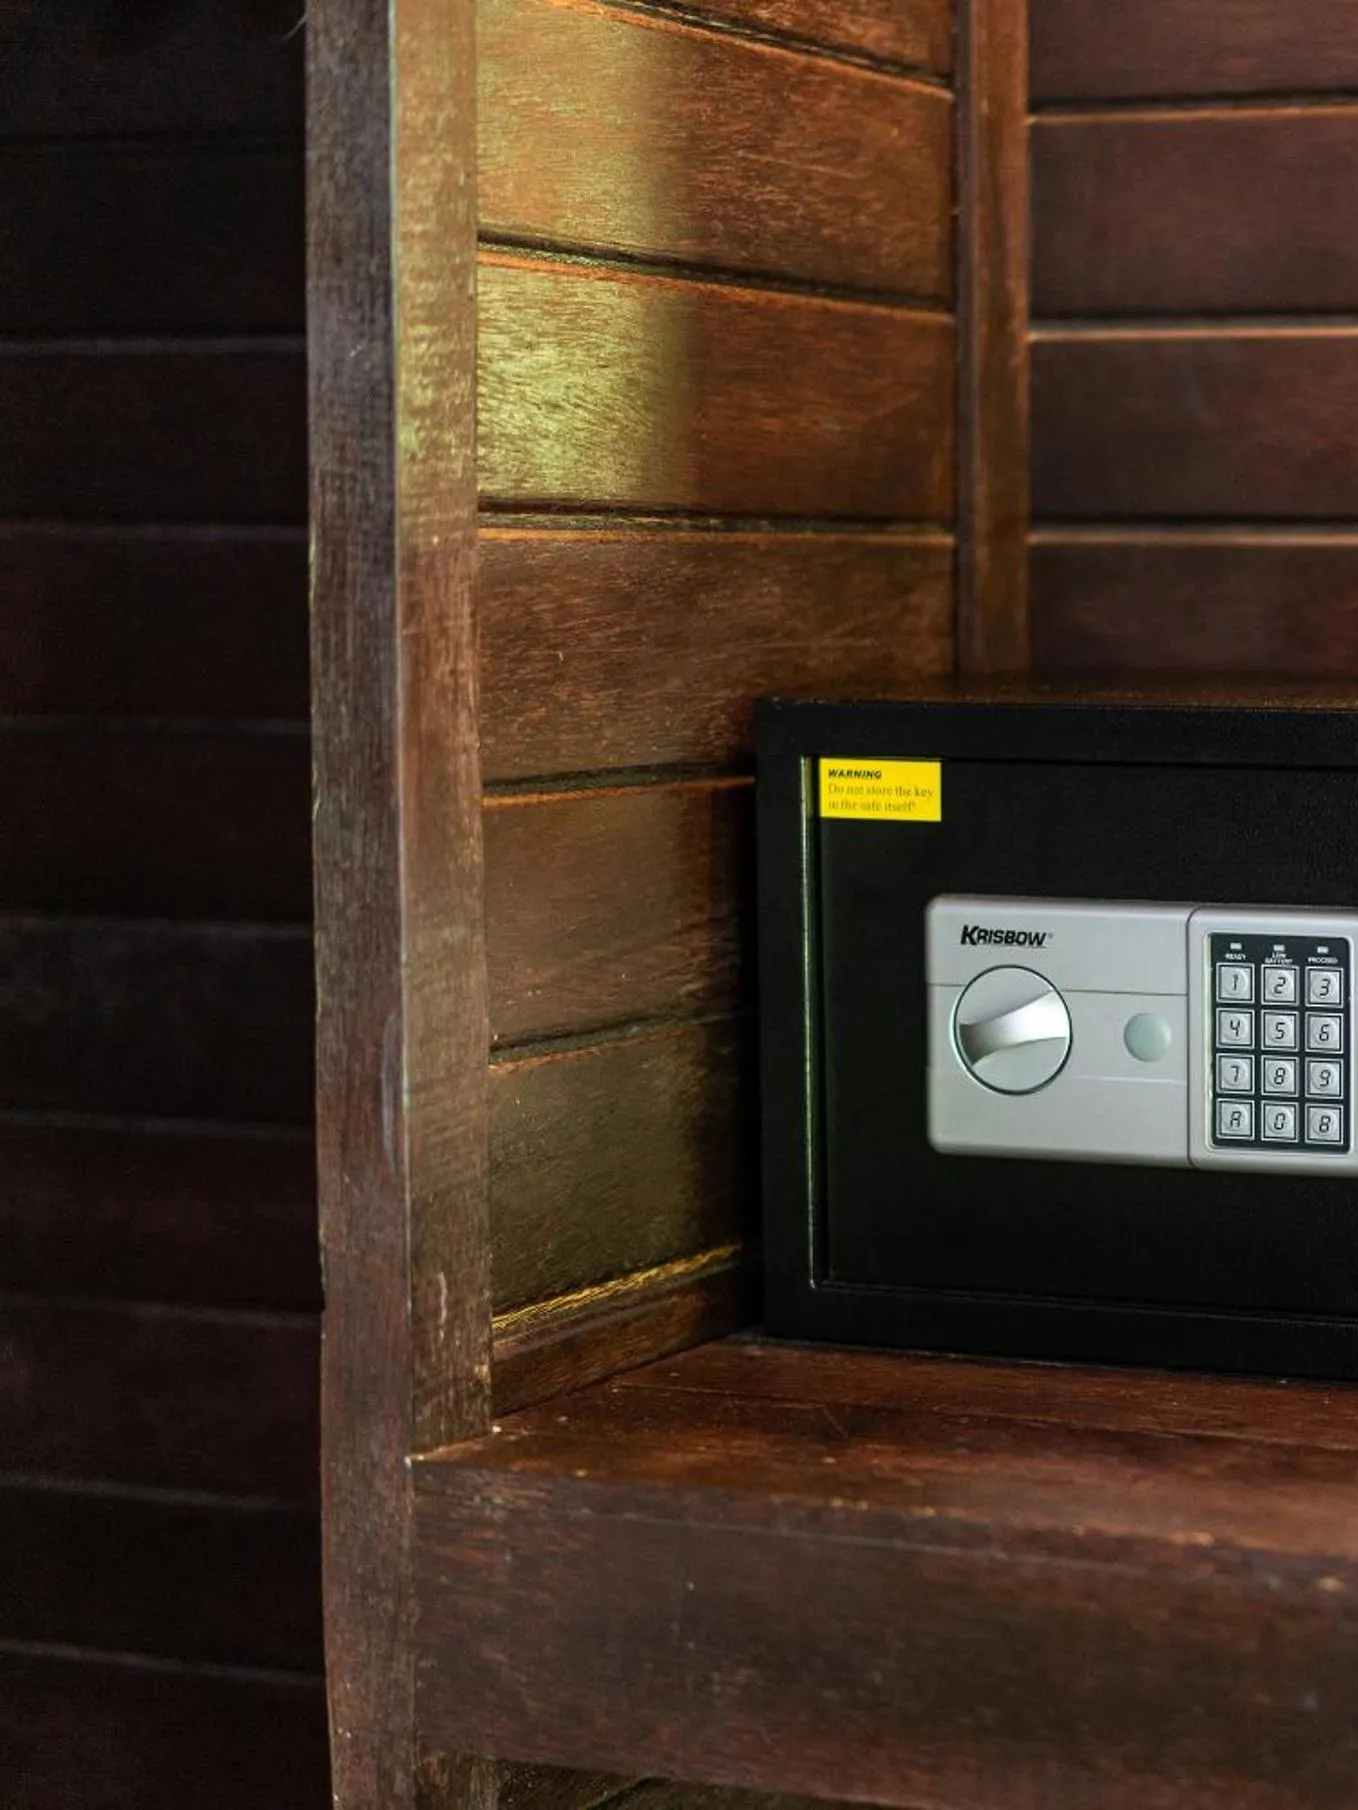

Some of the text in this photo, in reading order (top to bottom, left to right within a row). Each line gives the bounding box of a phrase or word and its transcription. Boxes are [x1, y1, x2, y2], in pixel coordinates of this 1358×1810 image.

[828, 769, 882, 780] WARNING
[828, 783, 934, 800] Do not store the key
[840, 800, 857, 810] the
[960, 925, 1047, 946] KRISBOW
[1232, 974, 1331, 996] 1 2 3
[1230, 1019, 1330, 1042] 4 5 6
[1231, 1065, 1331, 1087] 7 8 9
[1230, 1111, 1242, 1128] A
[1274, 1113, 1286, 1130] 0
